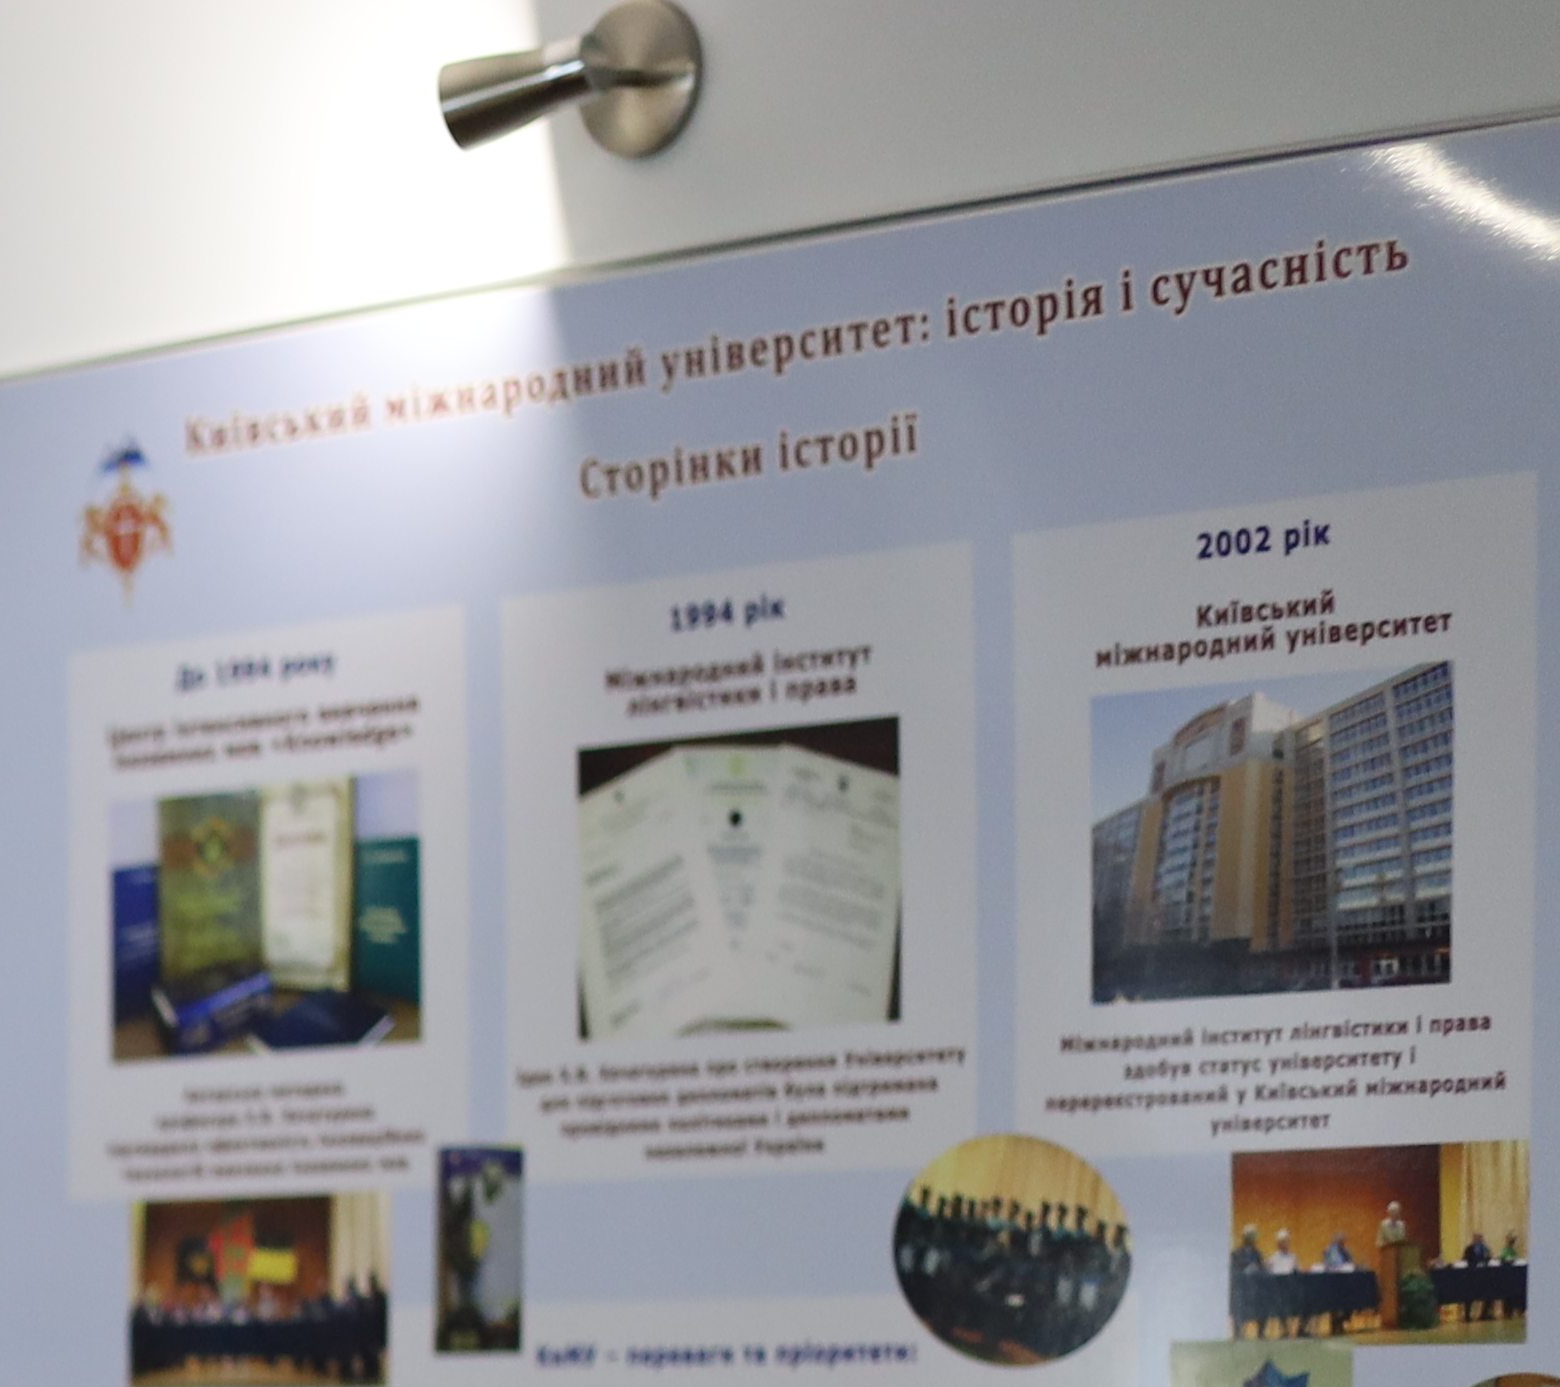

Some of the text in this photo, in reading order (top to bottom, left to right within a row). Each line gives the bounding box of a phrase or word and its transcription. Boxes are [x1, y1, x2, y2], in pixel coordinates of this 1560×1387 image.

[185, 239, 1410, 455] Київський міжнародний університет: історія і сучасність
[580, 412, 918, 499] Сторінки історії
[1197, 519, 1331, 559] 2002 рік
[671, 592, 785, 633] 1994 рік
[1197, 589, 1336, 628] Київський
[1095, 612, 1453, 668] міжнародний університет
[1060, 1028, 1195, 1054] Міжнародний
[1201, 1024, 1284, 1049] інститут
[1289, 1018, 1408, 1043] лінгвістики
[1429, 1013, 1492, 1037] права
[1198, 1054, 1262, 1077] статус
[1268, 1049, 1402, 1077] університету
[1255, 1077, 1358, 1103] Київський
[1365, 1070, 1507, 1097] міжнародний
[1211, 1111, 1331, 1137] університет
